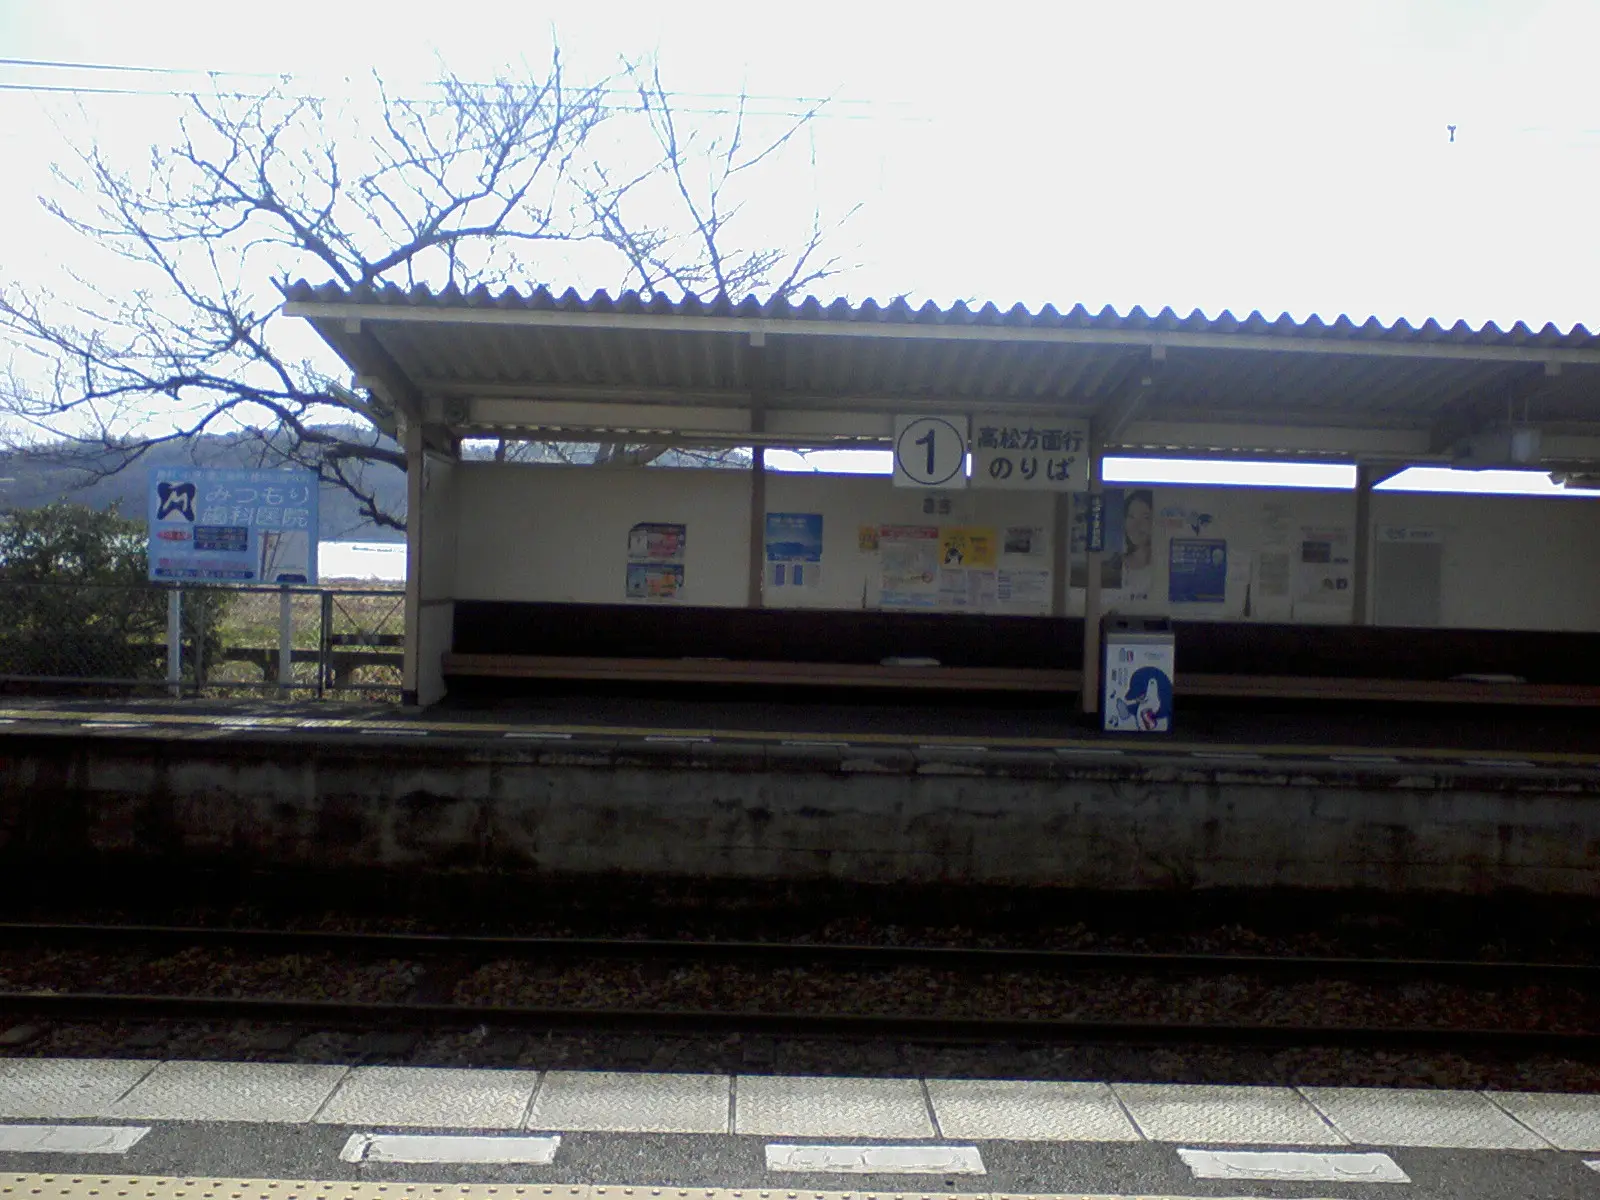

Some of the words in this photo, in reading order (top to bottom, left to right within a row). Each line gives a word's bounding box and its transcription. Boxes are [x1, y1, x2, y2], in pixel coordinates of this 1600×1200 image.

[978, 426, 1083, 452] 高松方面行
[989, 456, 1075, 481] のりば
[206, 485, 309, 505] みつもり
[202, 505, 309, 528] 歯科医院
